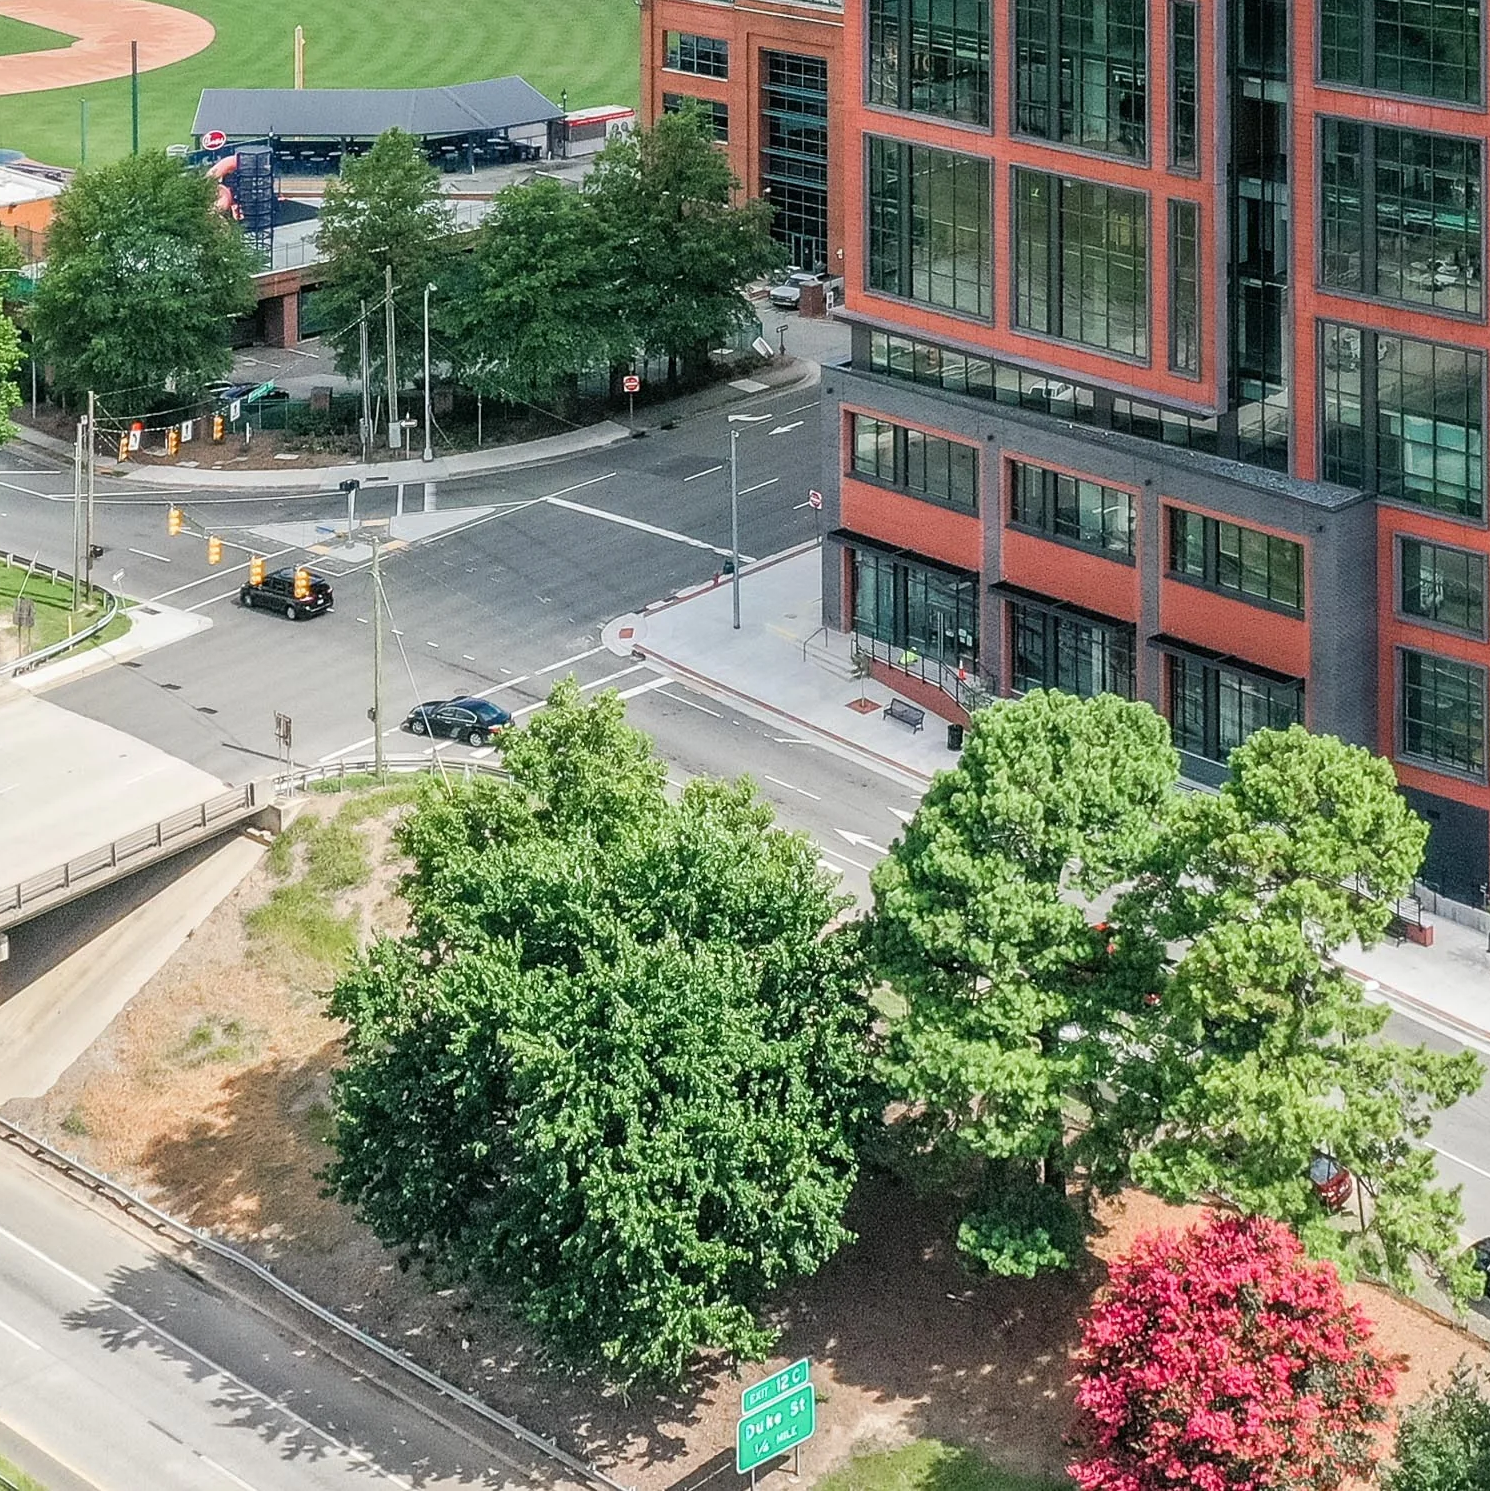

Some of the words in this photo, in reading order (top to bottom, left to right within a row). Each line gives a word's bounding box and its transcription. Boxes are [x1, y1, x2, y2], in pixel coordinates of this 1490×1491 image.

[749, 1385, 770, 1406] EXIT
[745, 1412, 783, 1442] Duke
[790, 1397, 806, 1418] St
[776, 1424, 798, 1444] MILE
